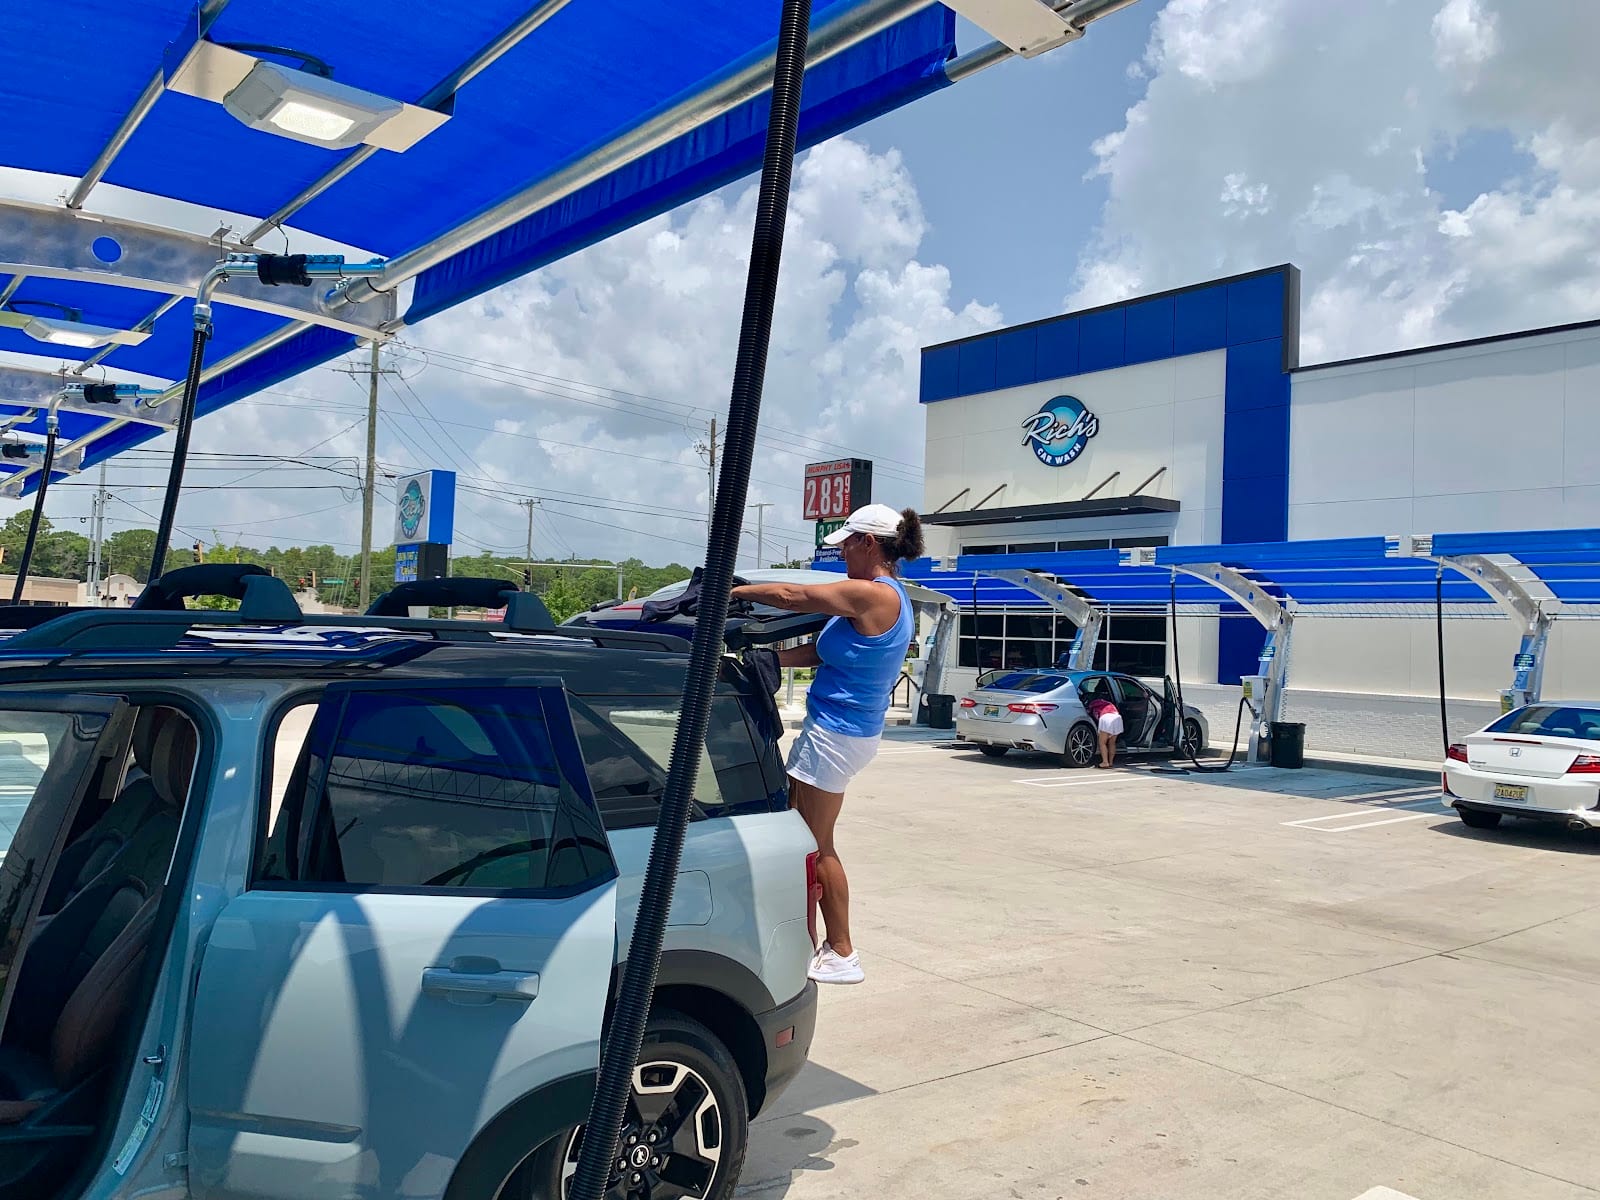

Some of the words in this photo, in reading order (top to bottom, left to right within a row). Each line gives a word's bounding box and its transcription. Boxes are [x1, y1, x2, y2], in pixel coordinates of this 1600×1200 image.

[1021, 409, 1099, 446] Rich's
[1037, 447, 1053, 464] CAR
[1055, 443, 1082, 464] WASH
[807, 464, 832, 474] MURPHY
